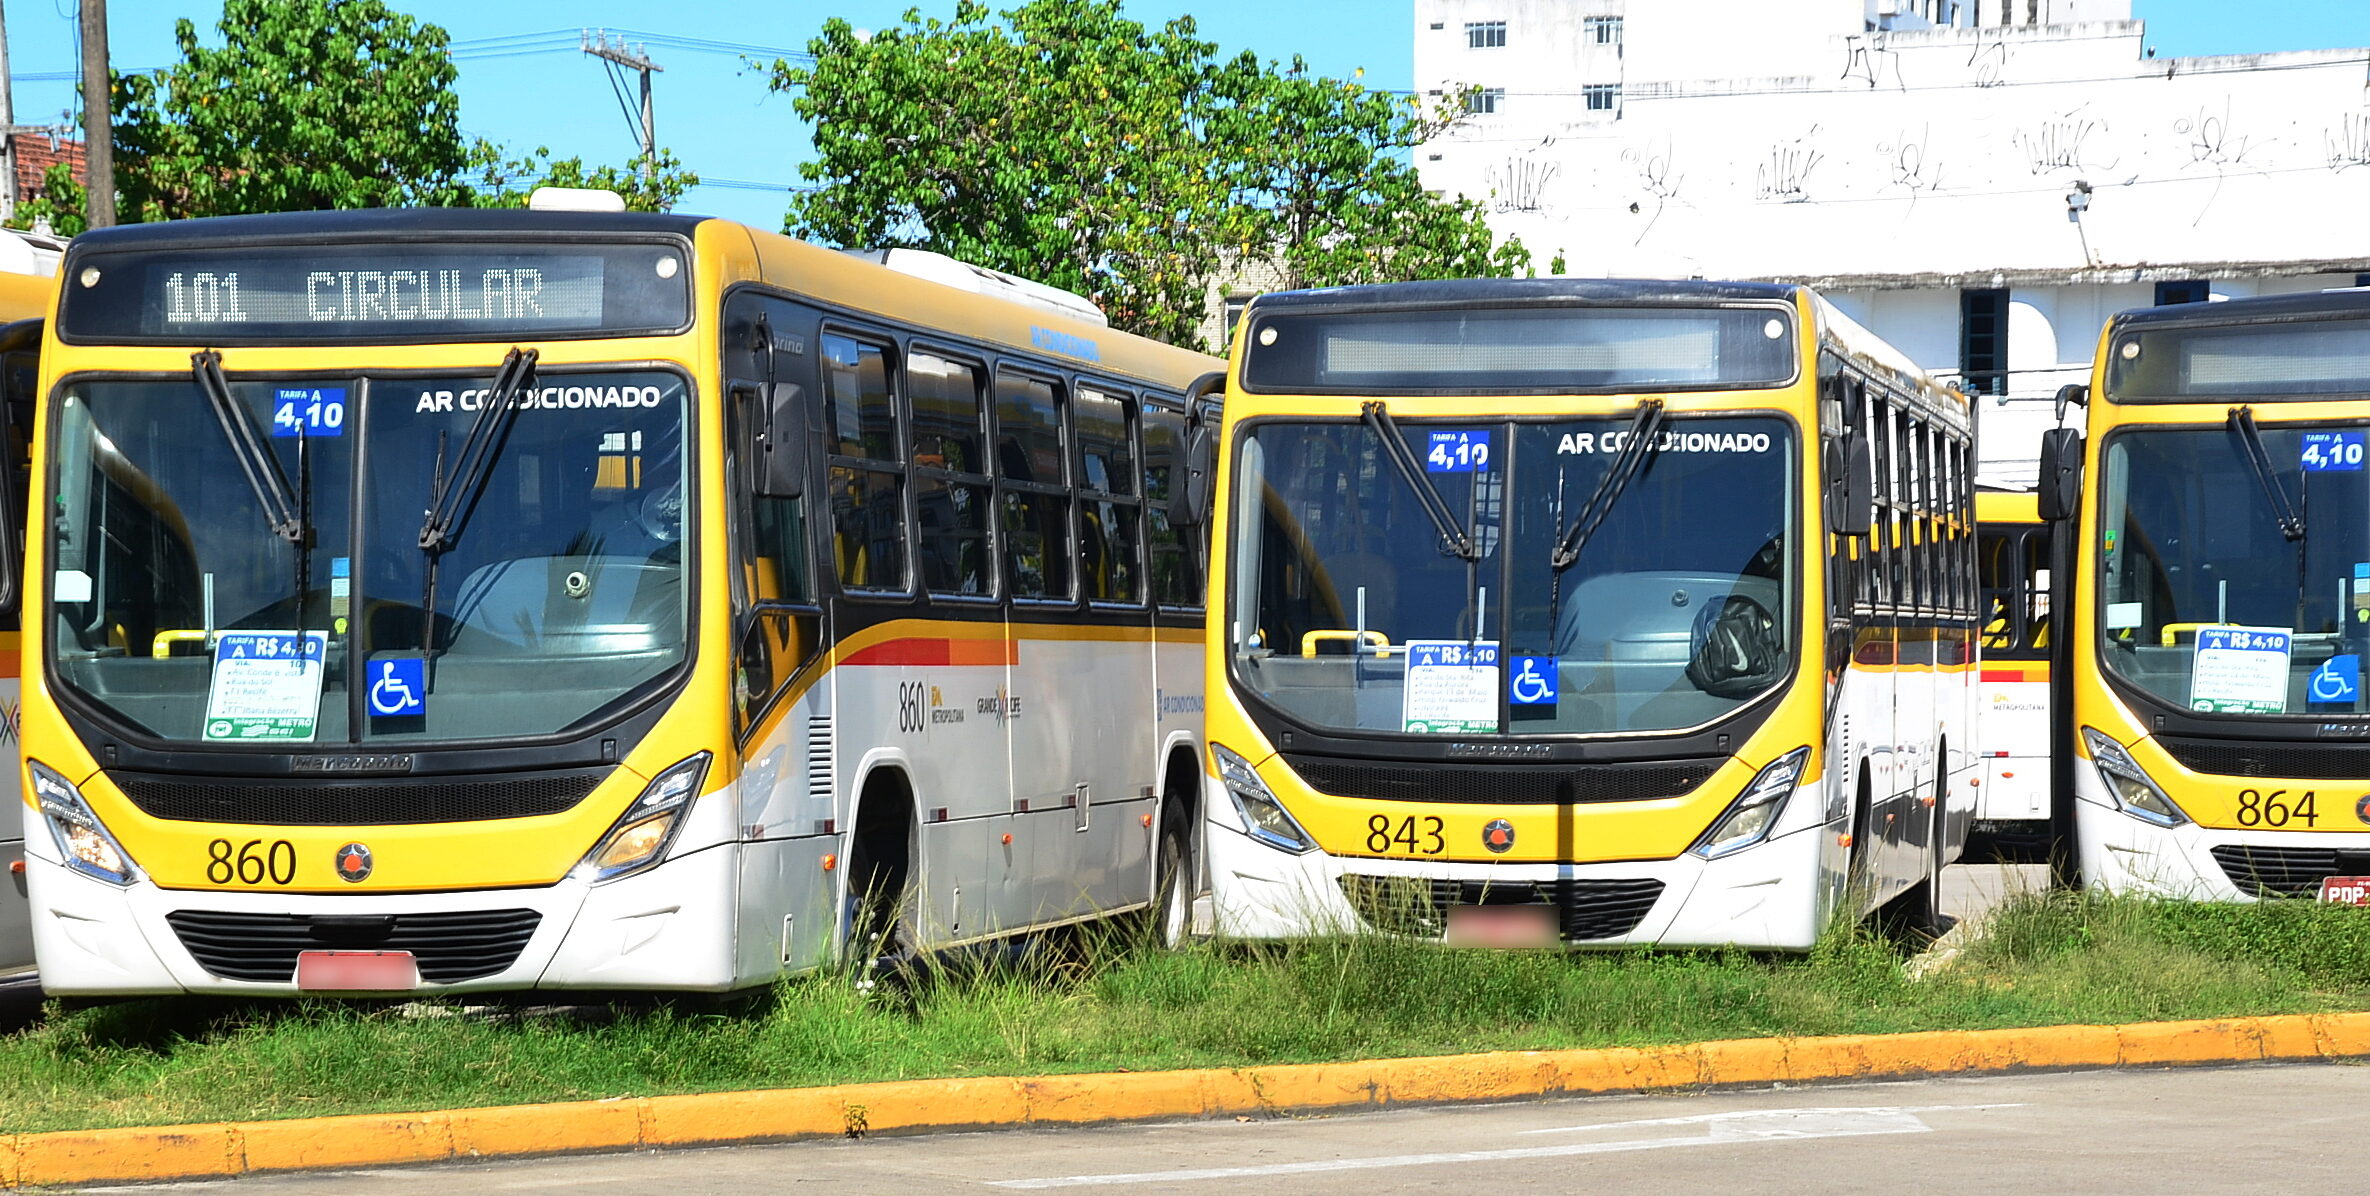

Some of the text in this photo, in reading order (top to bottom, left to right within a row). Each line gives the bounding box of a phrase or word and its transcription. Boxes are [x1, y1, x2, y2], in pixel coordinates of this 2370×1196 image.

[166, 268, 543, 322] 101 CIRCULAR
[280, 389, 321, 402] TARIFA A
[416, 391, 454, 413] AR
[274, 402, 343, 432] 4,10
[1433, 432, 1469, 443] TARIFA A
[1557, 433, 1594, 454] AR
[2306, 433, 2343, 444] TARIFA A
[1428, 443, 1489, 470] 4,10
[2301, 443, 2363, 469] 4,10
[227, 636, 317, 658] TARIFA R$ 4,0
[2210, 638, 2223, 648] A
[2231, 632, 2250, 649] R$
[2252, 635, 2284, 650] 4,10
[232, 644, 246, 658] A
[1421, 653, 1434, 665] A
[1442, 646, 1462, 665] R$
[290, 660, 306, 668] 10
[900, 681, 925, 733] 860
[1170, 695, 1204, 713] CONDICIONAD
[277, 718, 312, 728] METRO
[1468, 720, 1498, 729] METRO
[2236, 788, 2319, 828] 864
[1367, 815, 1445, 856] 843
[207, 839, 296, 885] 860
